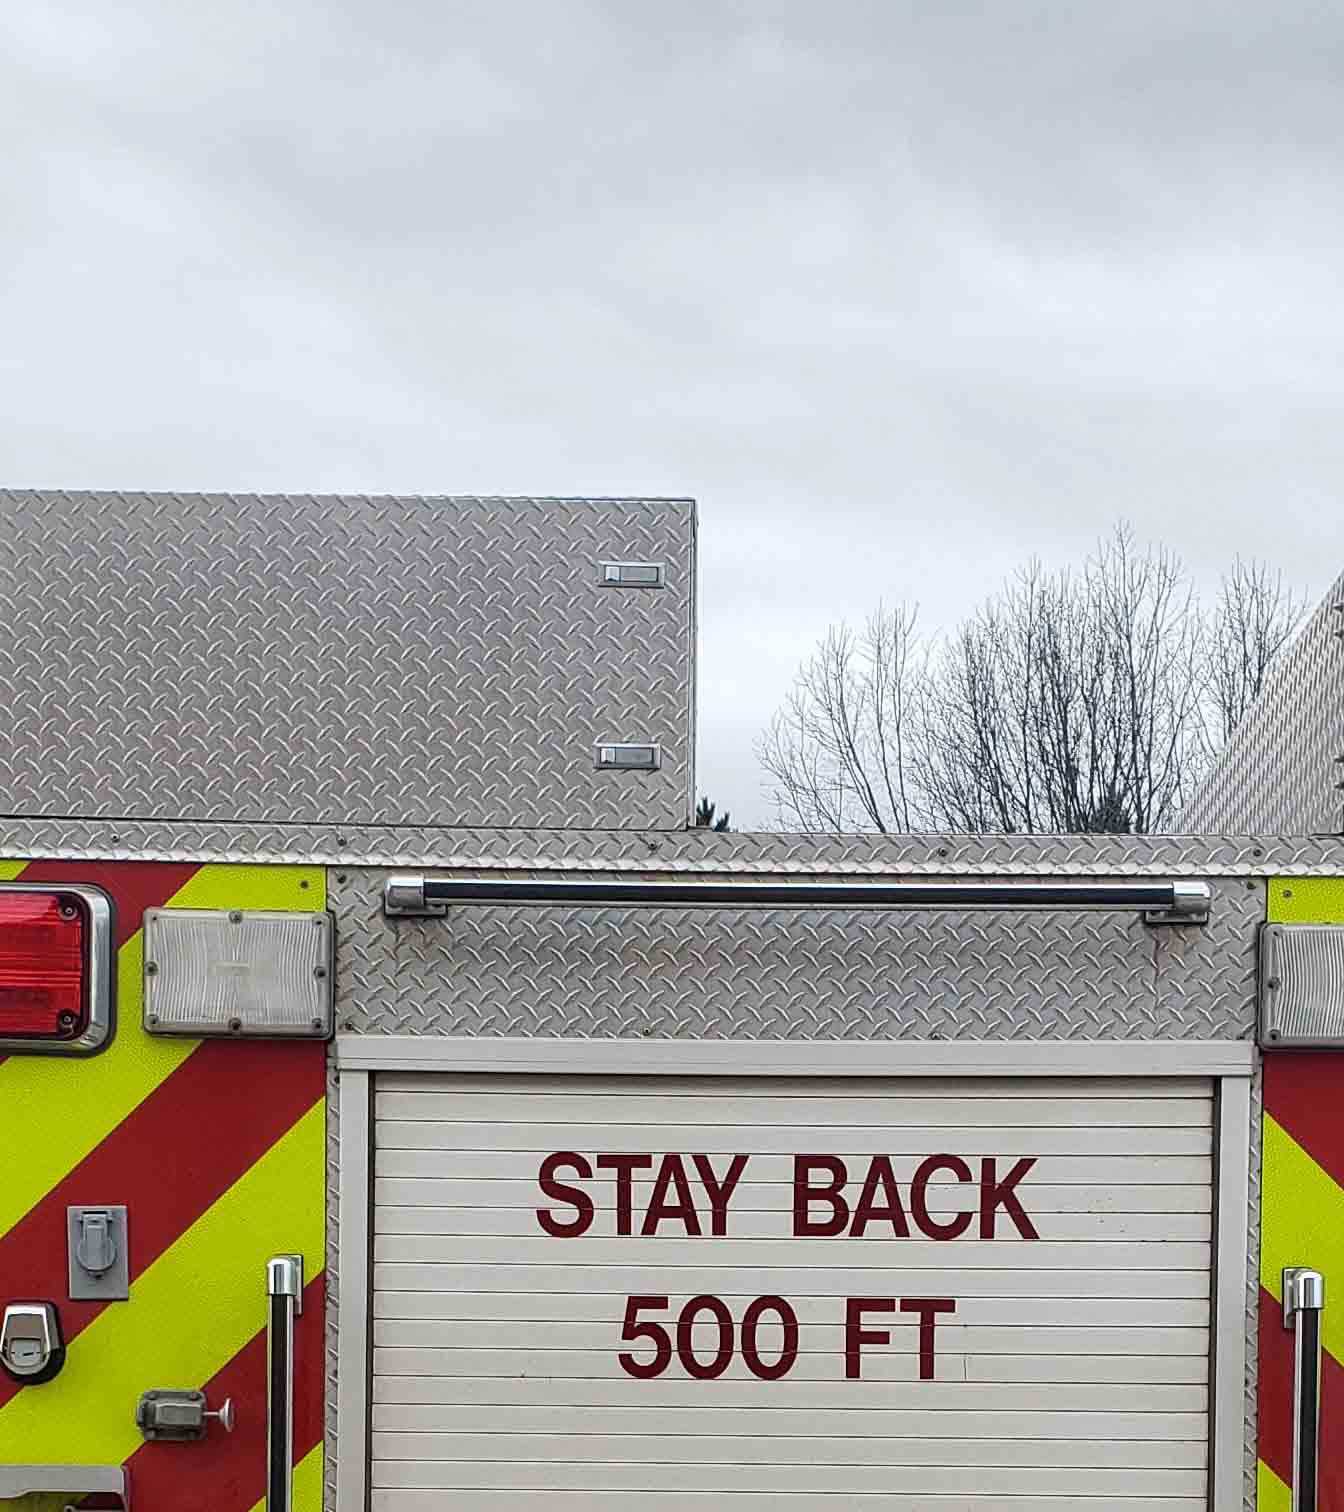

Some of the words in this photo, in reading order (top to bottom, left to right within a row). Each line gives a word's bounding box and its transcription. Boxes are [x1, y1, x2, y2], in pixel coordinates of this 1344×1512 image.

[536, 1151, 750, 1239] STAY
[793, 1153, 1040, 1241] BACK
[618, 1295, 798, 1381] 500
[845, 1297, 956, 1380] FT
